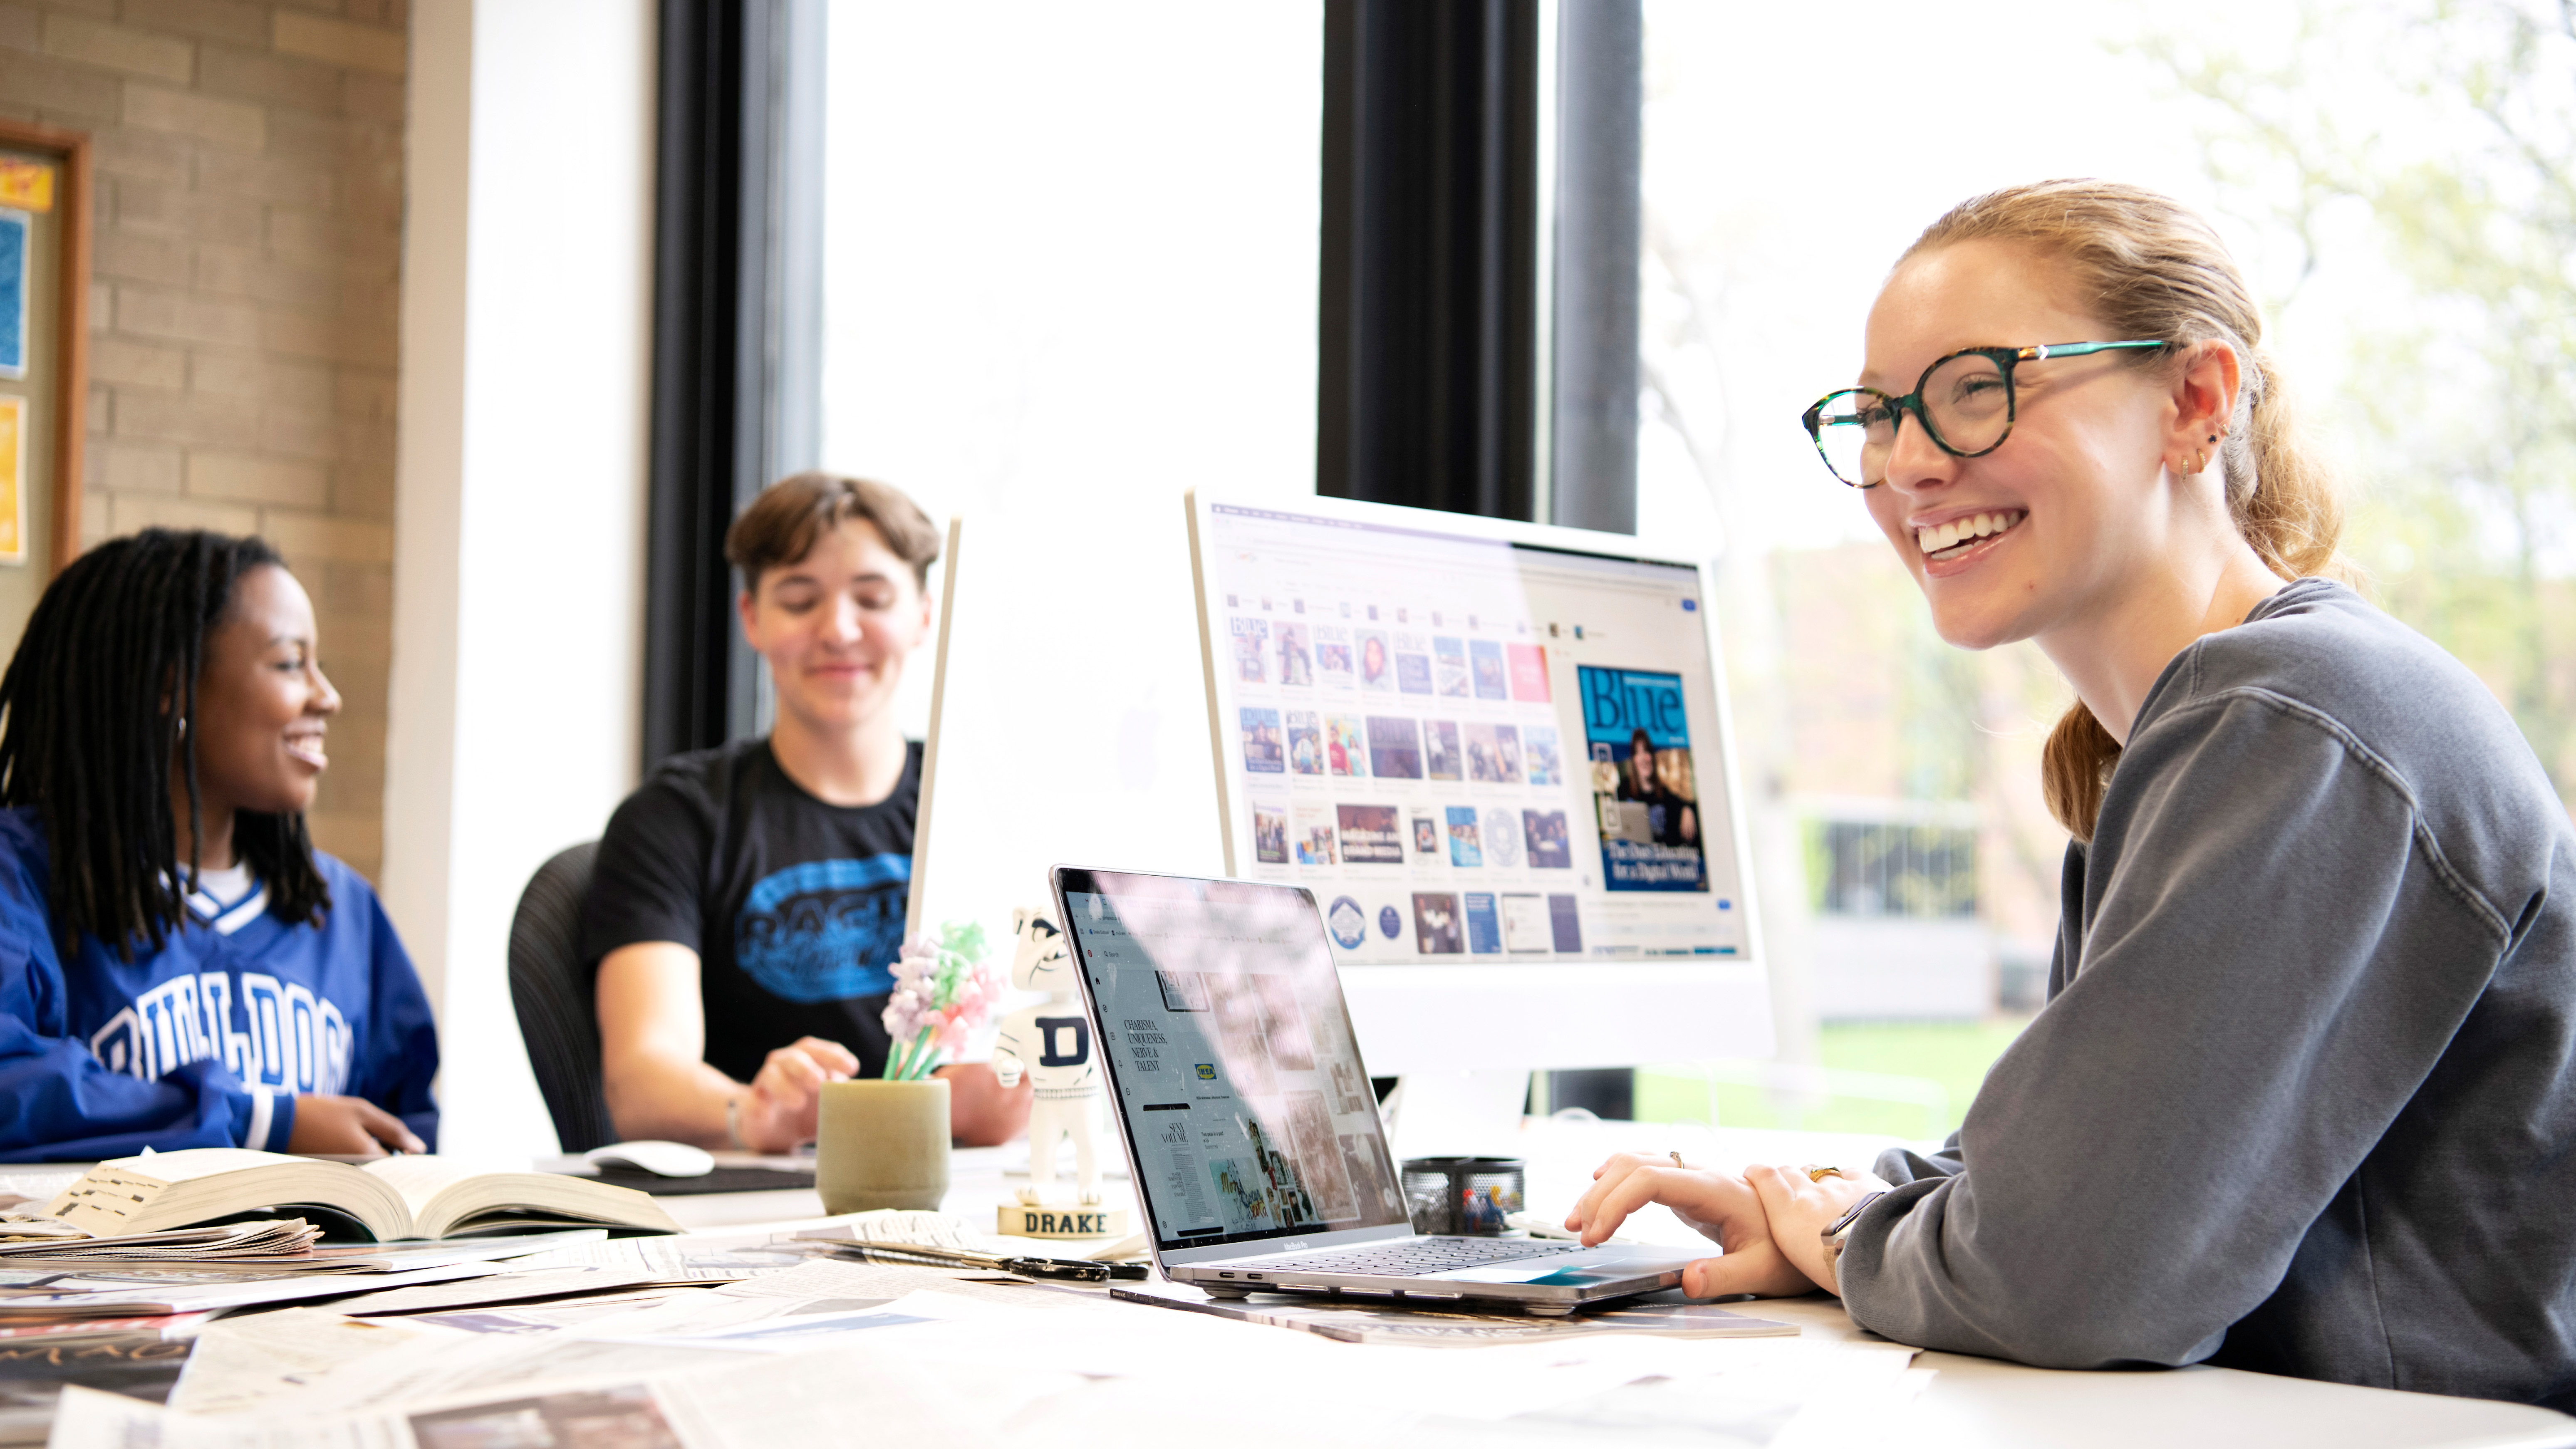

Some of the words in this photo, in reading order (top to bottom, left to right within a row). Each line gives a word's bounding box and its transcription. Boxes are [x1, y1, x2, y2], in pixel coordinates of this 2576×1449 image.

[1586, 667, 1683, 732] Blue
[1124, 1020, 1158, 1031] CHARISMA,
[1035, 1017, 1089, 1067] D
[1127, 1033, 1167, 1046] UNIQUENESS,
[1131, 1048, 1153, 1058] NERVE
[1154, 1048, 1159, 1058] &
[1135, 1061, 1159, 1071] TALENT
[1161, 1132, 1188, 1143] VOLUME
[1025, 1211, 1107, 1234] DRAKE
[1283, 1242, 1302, 1251] MacBook
